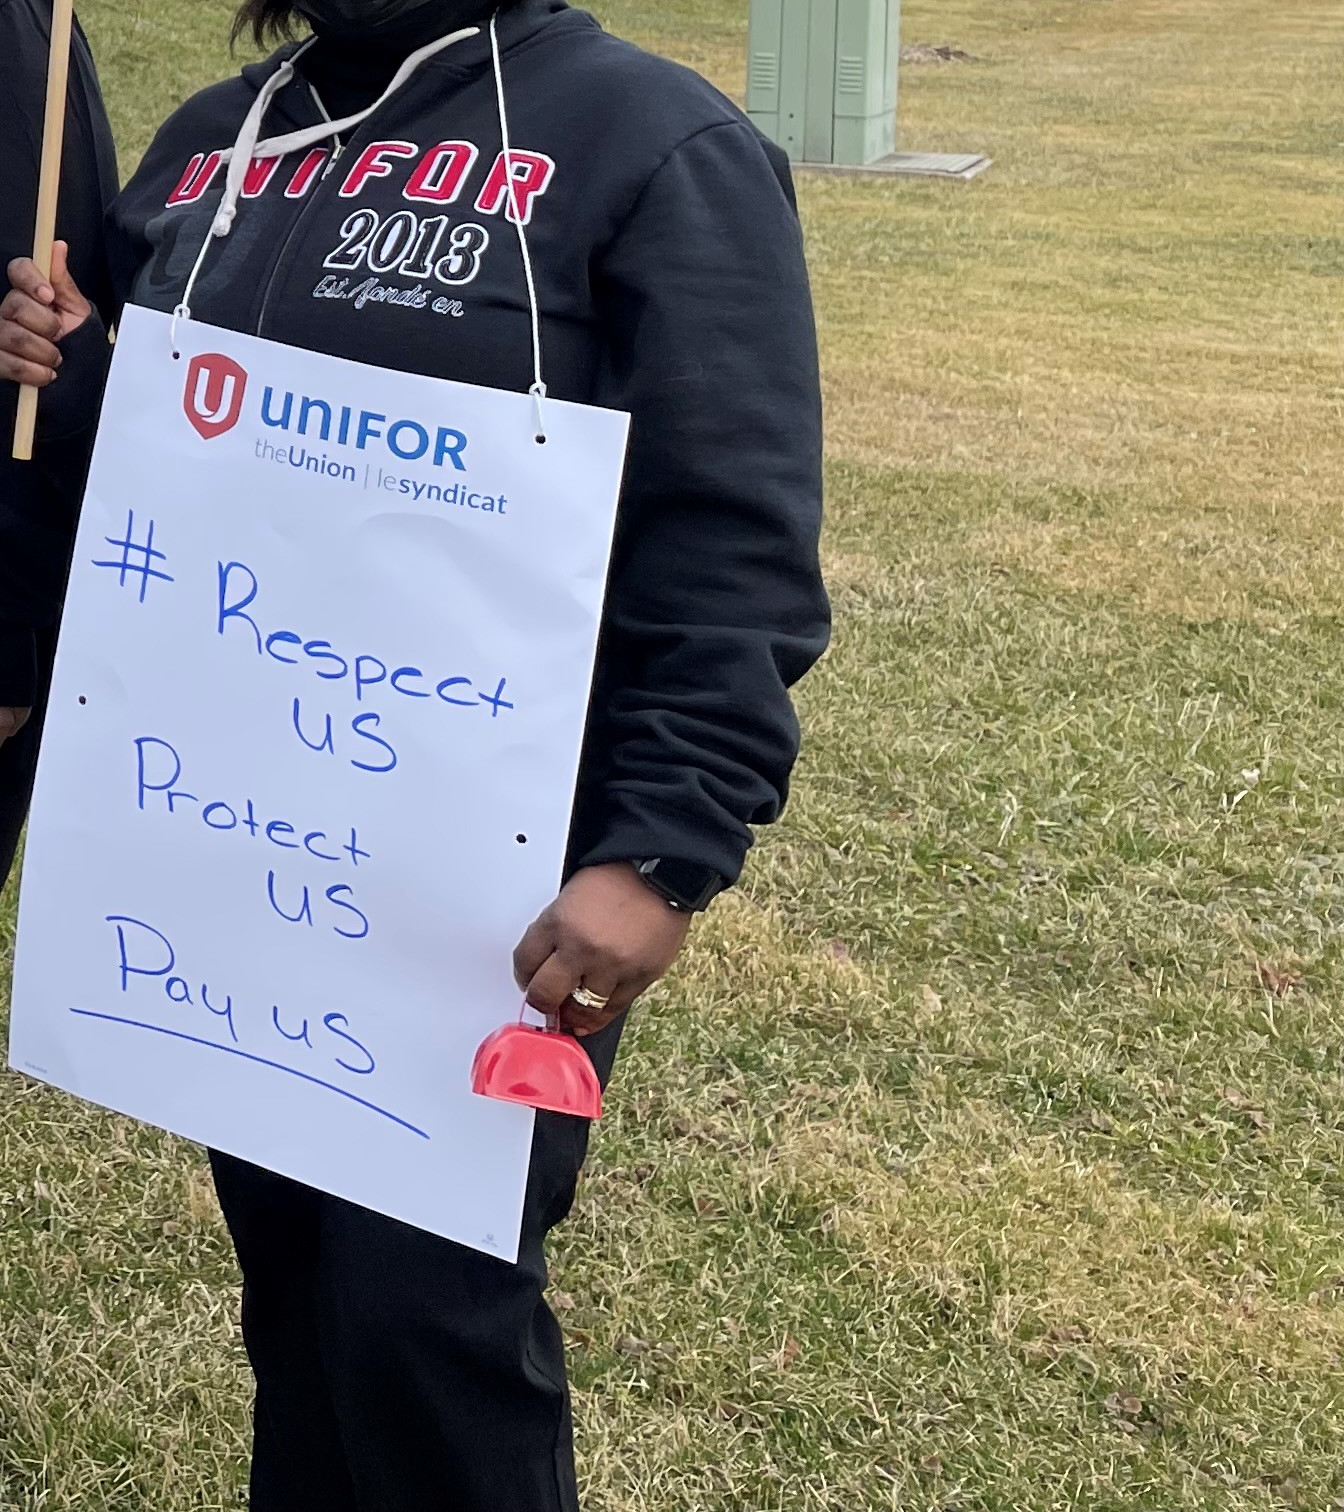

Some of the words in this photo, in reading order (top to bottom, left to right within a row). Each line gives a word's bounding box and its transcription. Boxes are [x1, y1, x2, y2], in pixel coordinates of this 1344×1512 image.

[323, 208, 489, 285] 2013
[254, 438, 356, 482] theUnion
[377, 468, 509, 515] lesyndicat
[217, 560, 514, 718] Respect
[133, 735, 371, 867] Protect
[105, 915, 239, 1044] Pay
